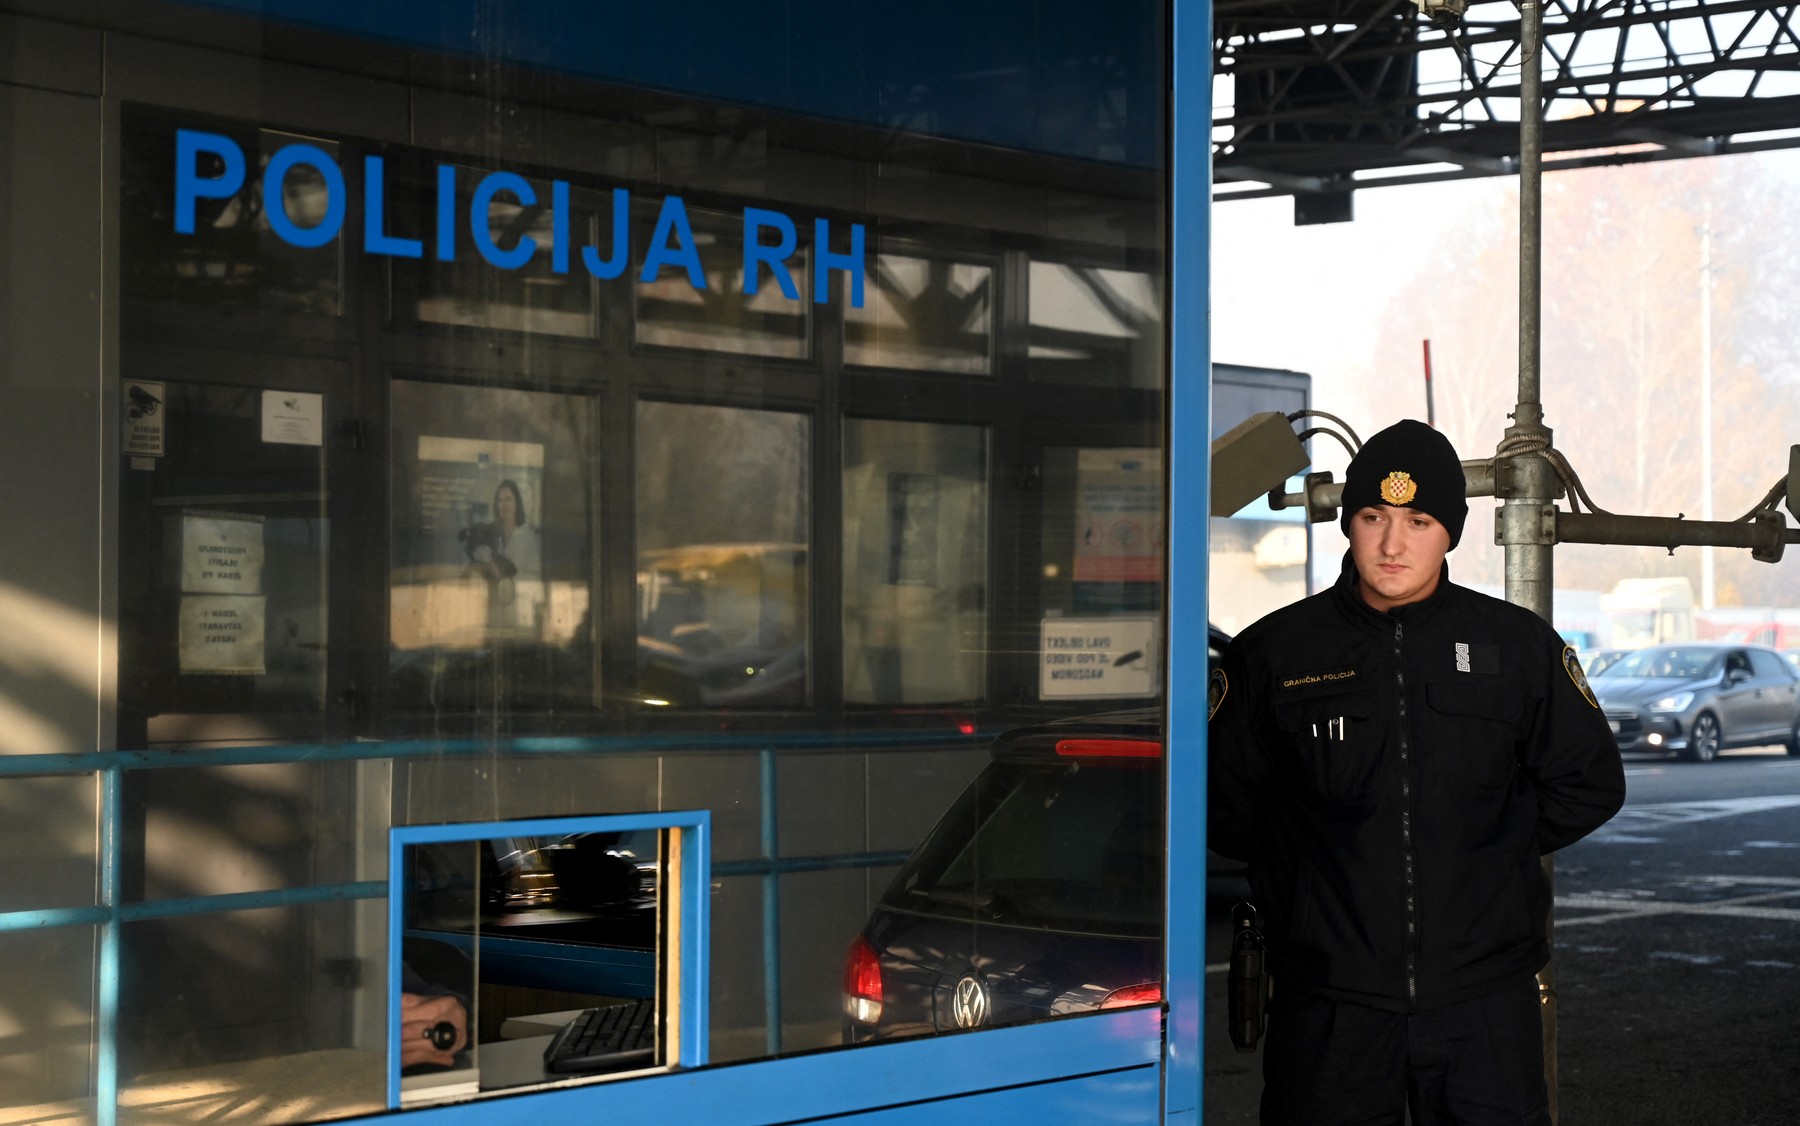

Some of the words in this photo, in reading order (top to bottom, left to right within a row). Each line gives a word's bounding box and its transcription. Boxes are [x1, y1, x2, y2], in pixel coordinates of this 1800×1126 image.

[175, 130, 706, 288] POLICIJA
[742, 207, 866, 309] RH
[1283, 675, 1322, 687] GRANIČNA
[1323, 670, 1356, 681] POLICIJA
